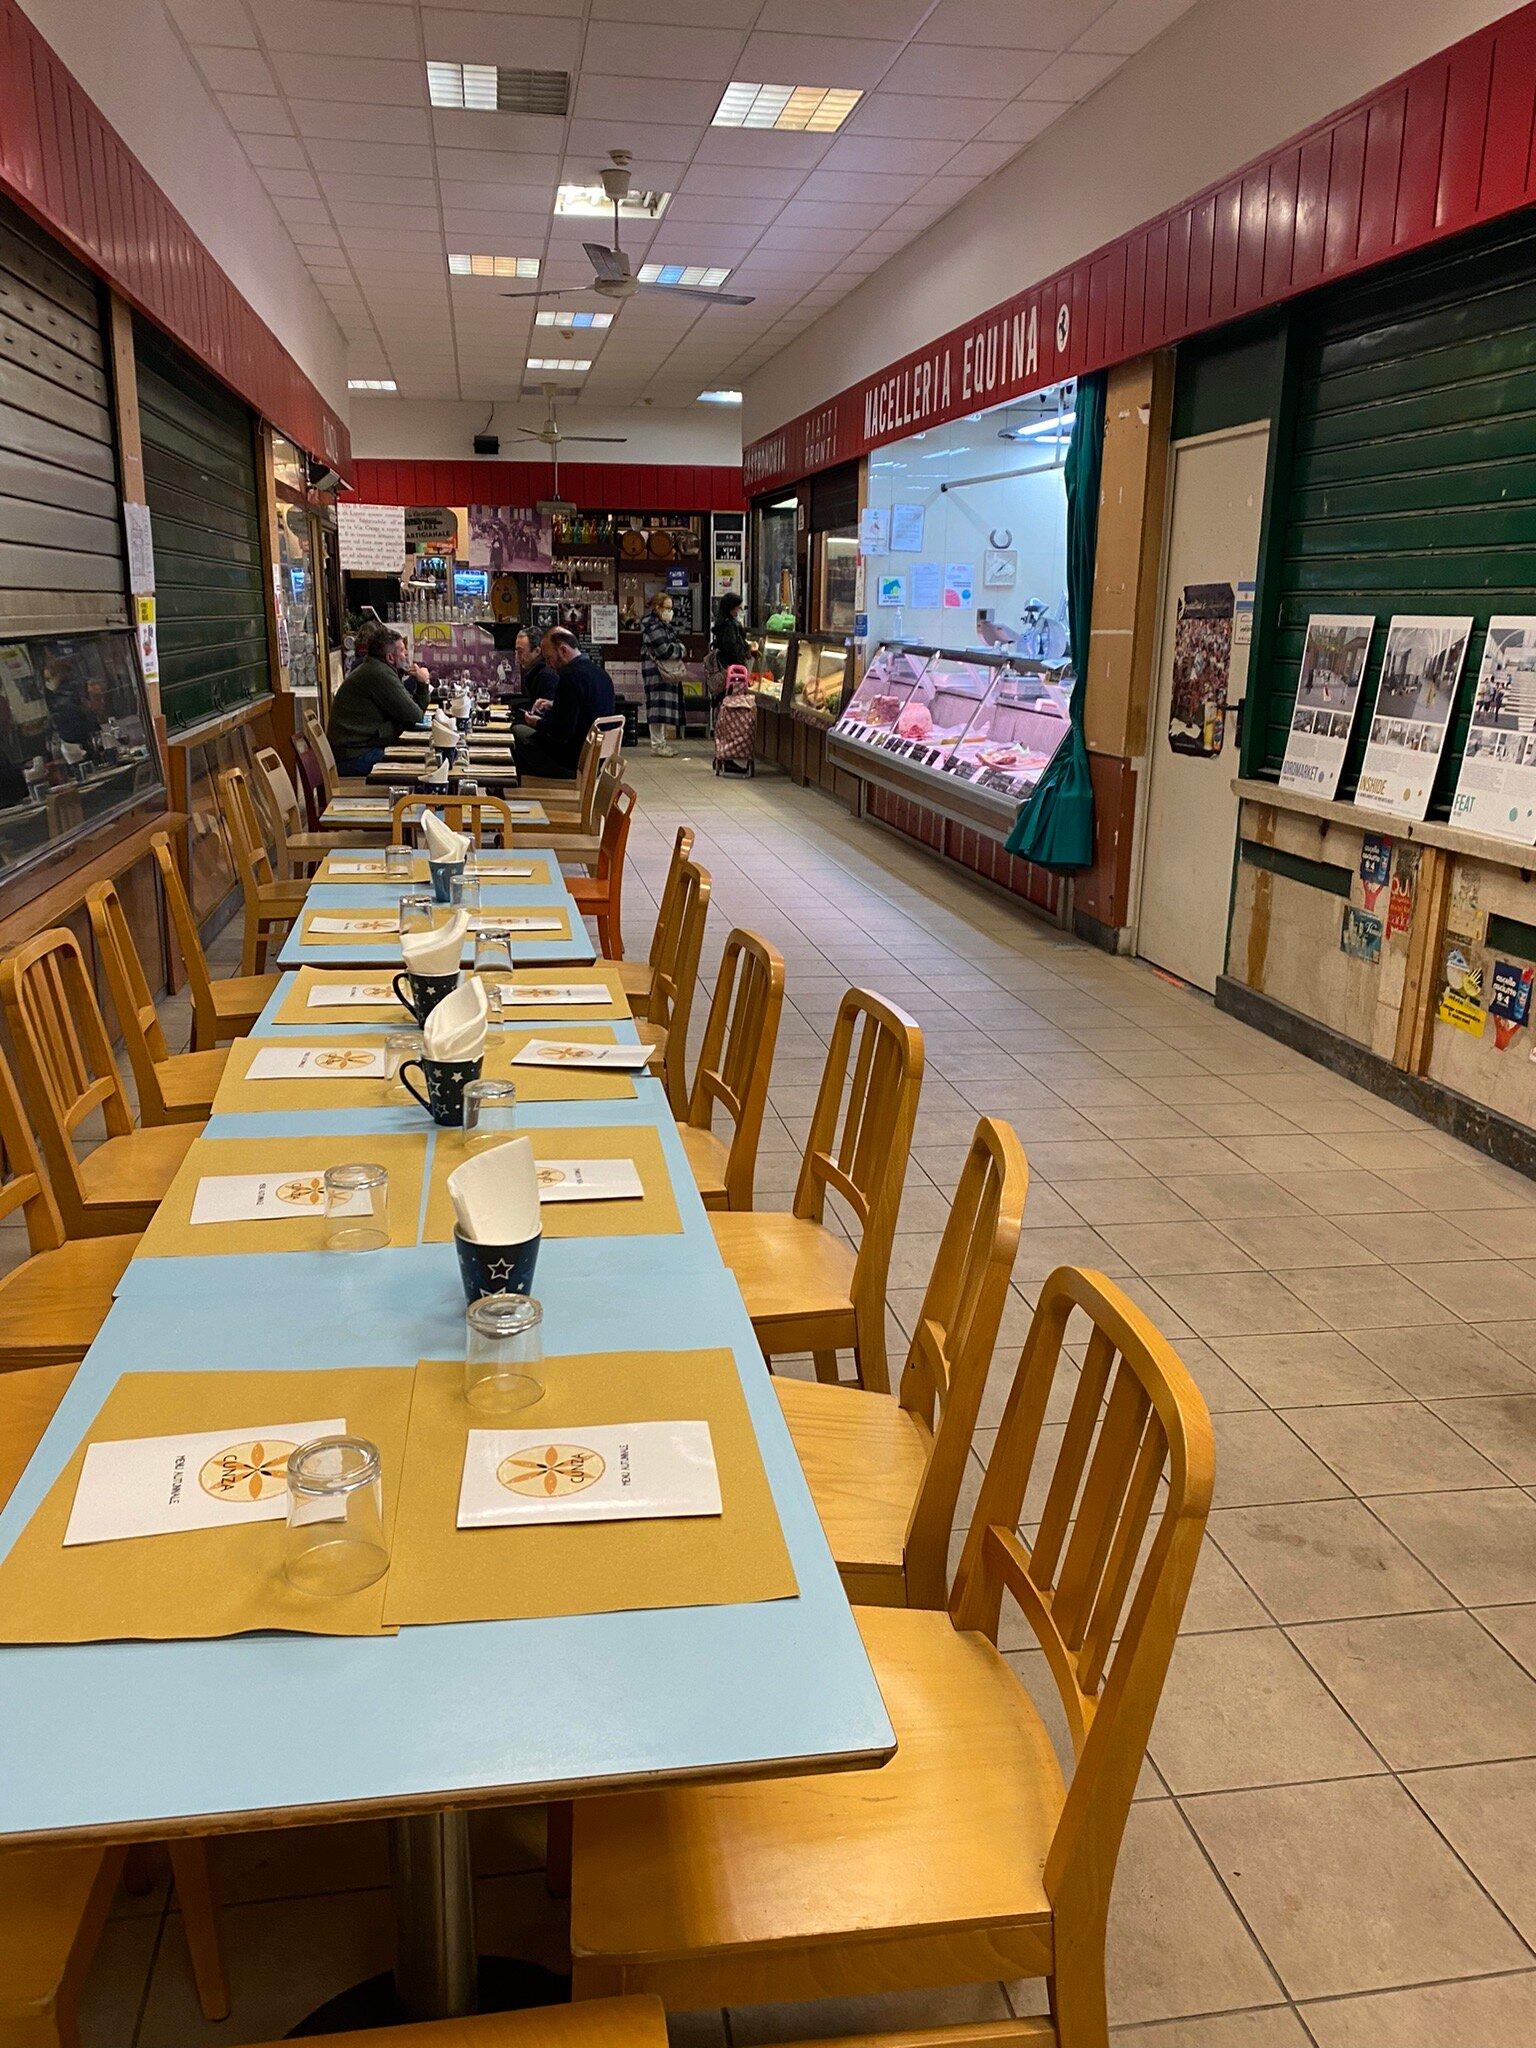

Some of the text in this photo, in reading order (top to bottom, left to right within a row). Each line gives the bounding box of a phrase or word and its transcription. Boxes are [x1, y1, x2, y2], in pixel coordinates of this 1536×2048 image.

[864, 305, 1038, 440] MACELLERIA EQUINA
[805, 406, 838, 446] PIATTI
[804, 434, 837, 469] PRONTI
[1454, 793, 1476, 813] FEAT
[221, 1453, 237, 1492] CUNZA
[570, 1452, 585, 1485] CUNZA
